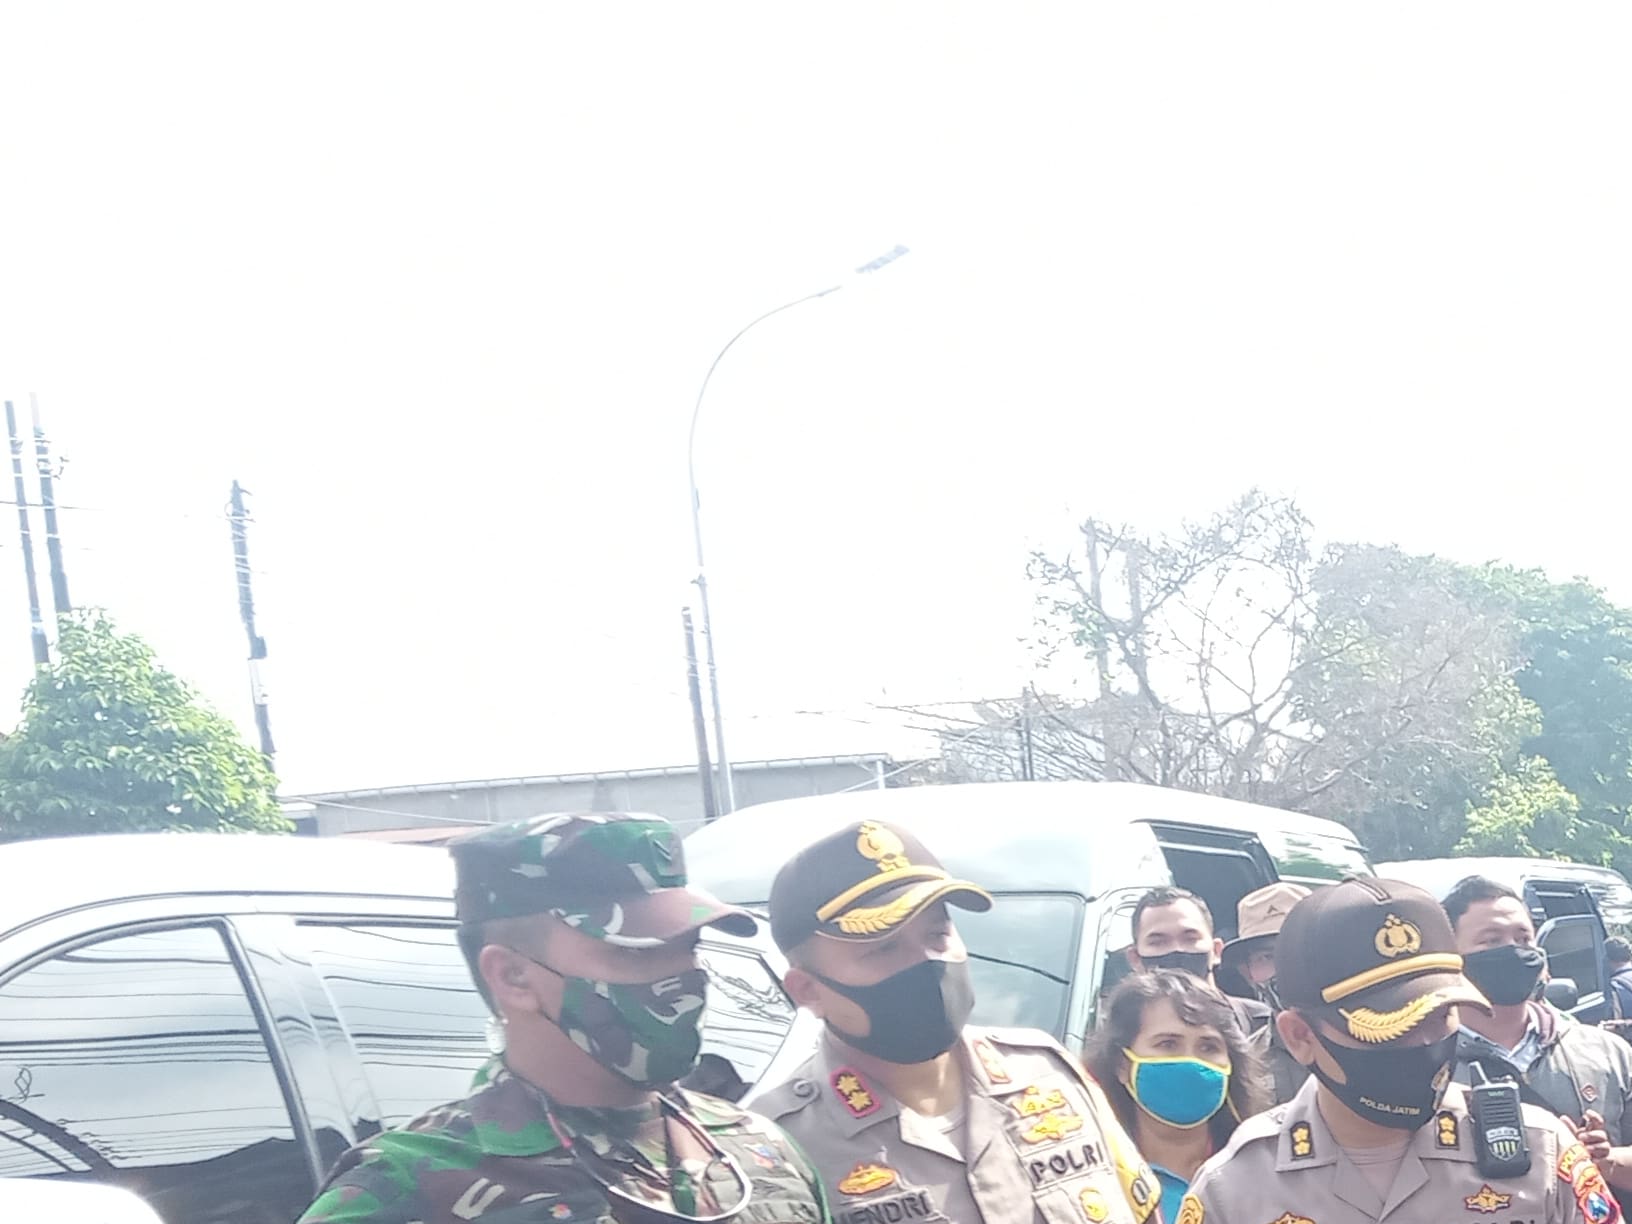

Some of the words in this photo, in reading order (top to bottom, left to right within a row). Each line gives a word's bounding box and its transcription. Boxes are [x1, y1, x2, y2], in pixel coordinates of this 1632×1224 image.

[1359, 1096, 1392, 1113] POLDA
[1391, 1105, 1422, 1117] JATIM
[1030, 1141, 1105, 1183] POLRI
